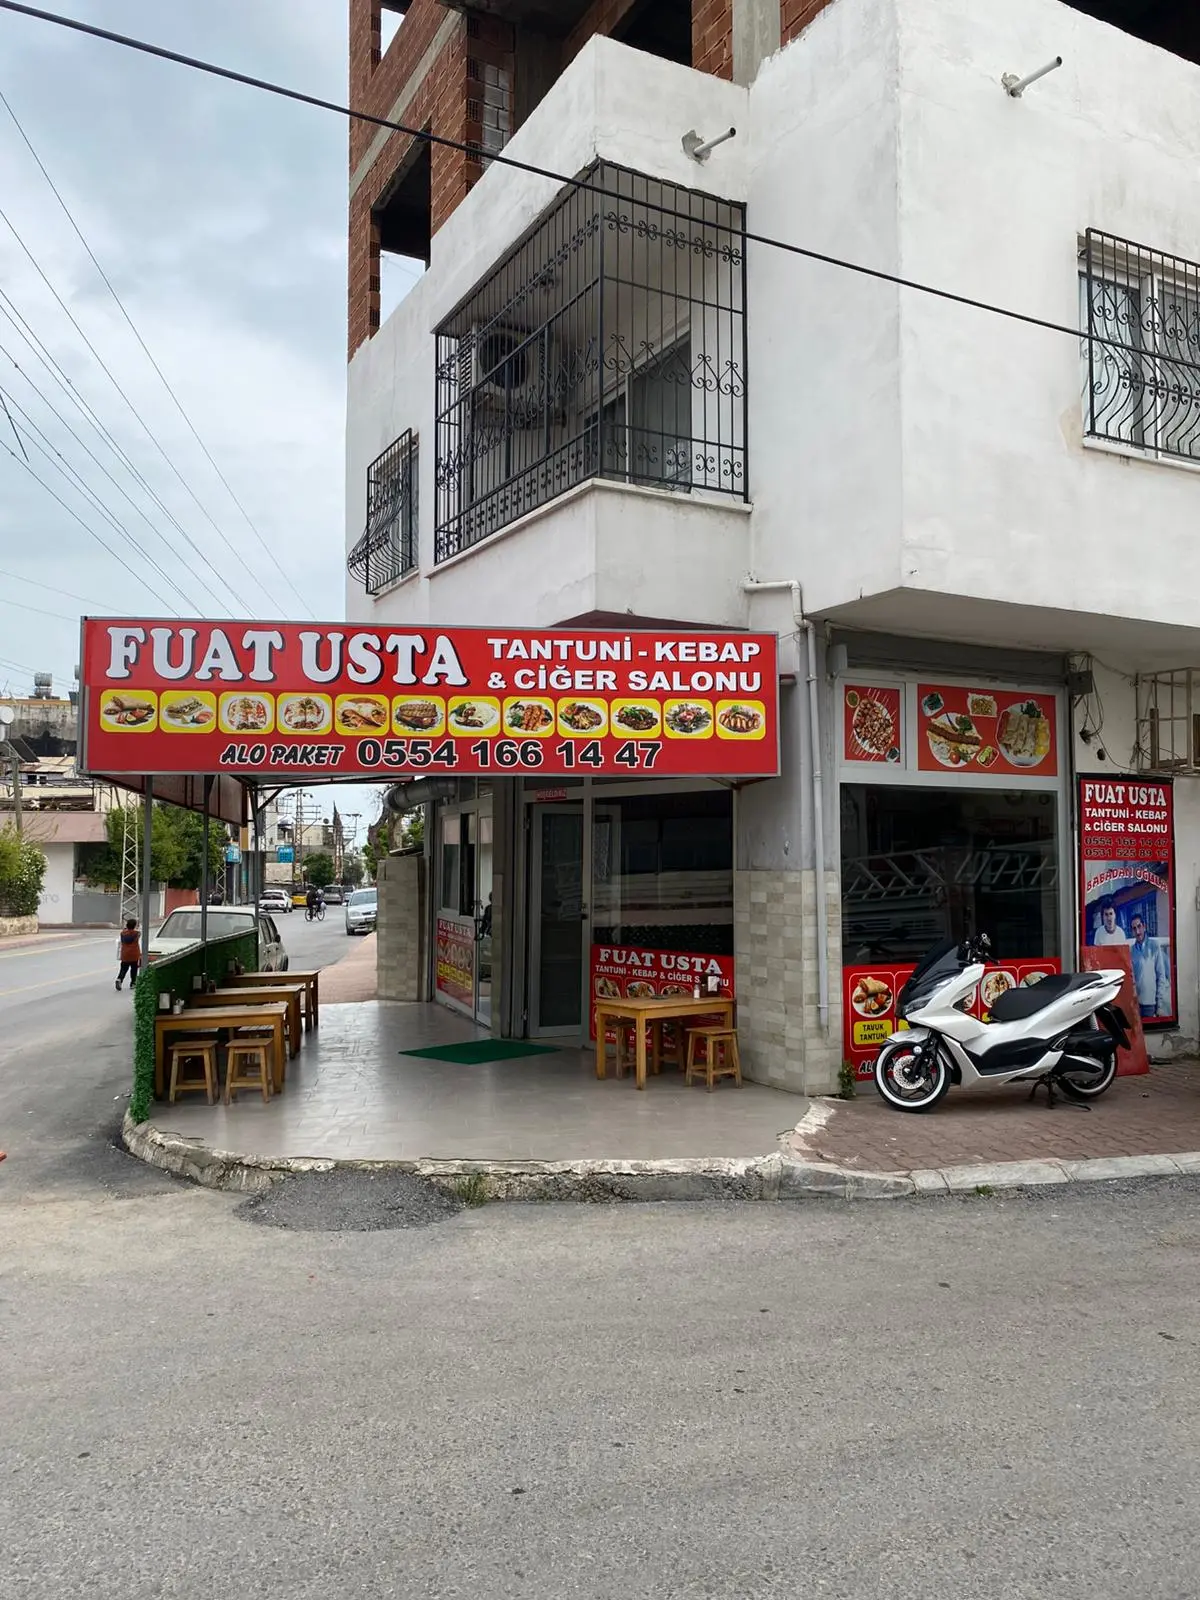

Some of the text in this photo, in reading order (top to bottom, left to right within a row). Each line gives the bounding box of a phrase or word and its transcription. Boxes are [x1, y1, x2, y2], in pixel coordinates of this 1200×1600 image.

[105, 627, 469, 686] FUAT USTA
[488, 637, 632, 662] TANTUNİ
[655, 641, 761, 664] KEBAP
[487, 662, 762, 692] & CİĞER SALONU
[220, 739, 662, 768] ALO PAKET 0554 166 14 47
[1085, 784, 1167, 806] FUAT USTA
[1085, 808, 1129, 818] TANTUNİ
[1136, 810, 1167, 820] KEBAP
[1085, 820, 1168, 833] & CİĞER SALONU
[1085, 836, 1168, 846] 0554 166 14 47
[599, 948, 723, 975] FUAT USTA
[595, 965, 627, 976] TANTUNİ
[632, 969, 657, 978] KEBAP
[668, 972, 692, 983] CİĞER
[860, 1031, 888, 1041] TANTUNİ
[863, 1023, 884, 1031] TAVUK
